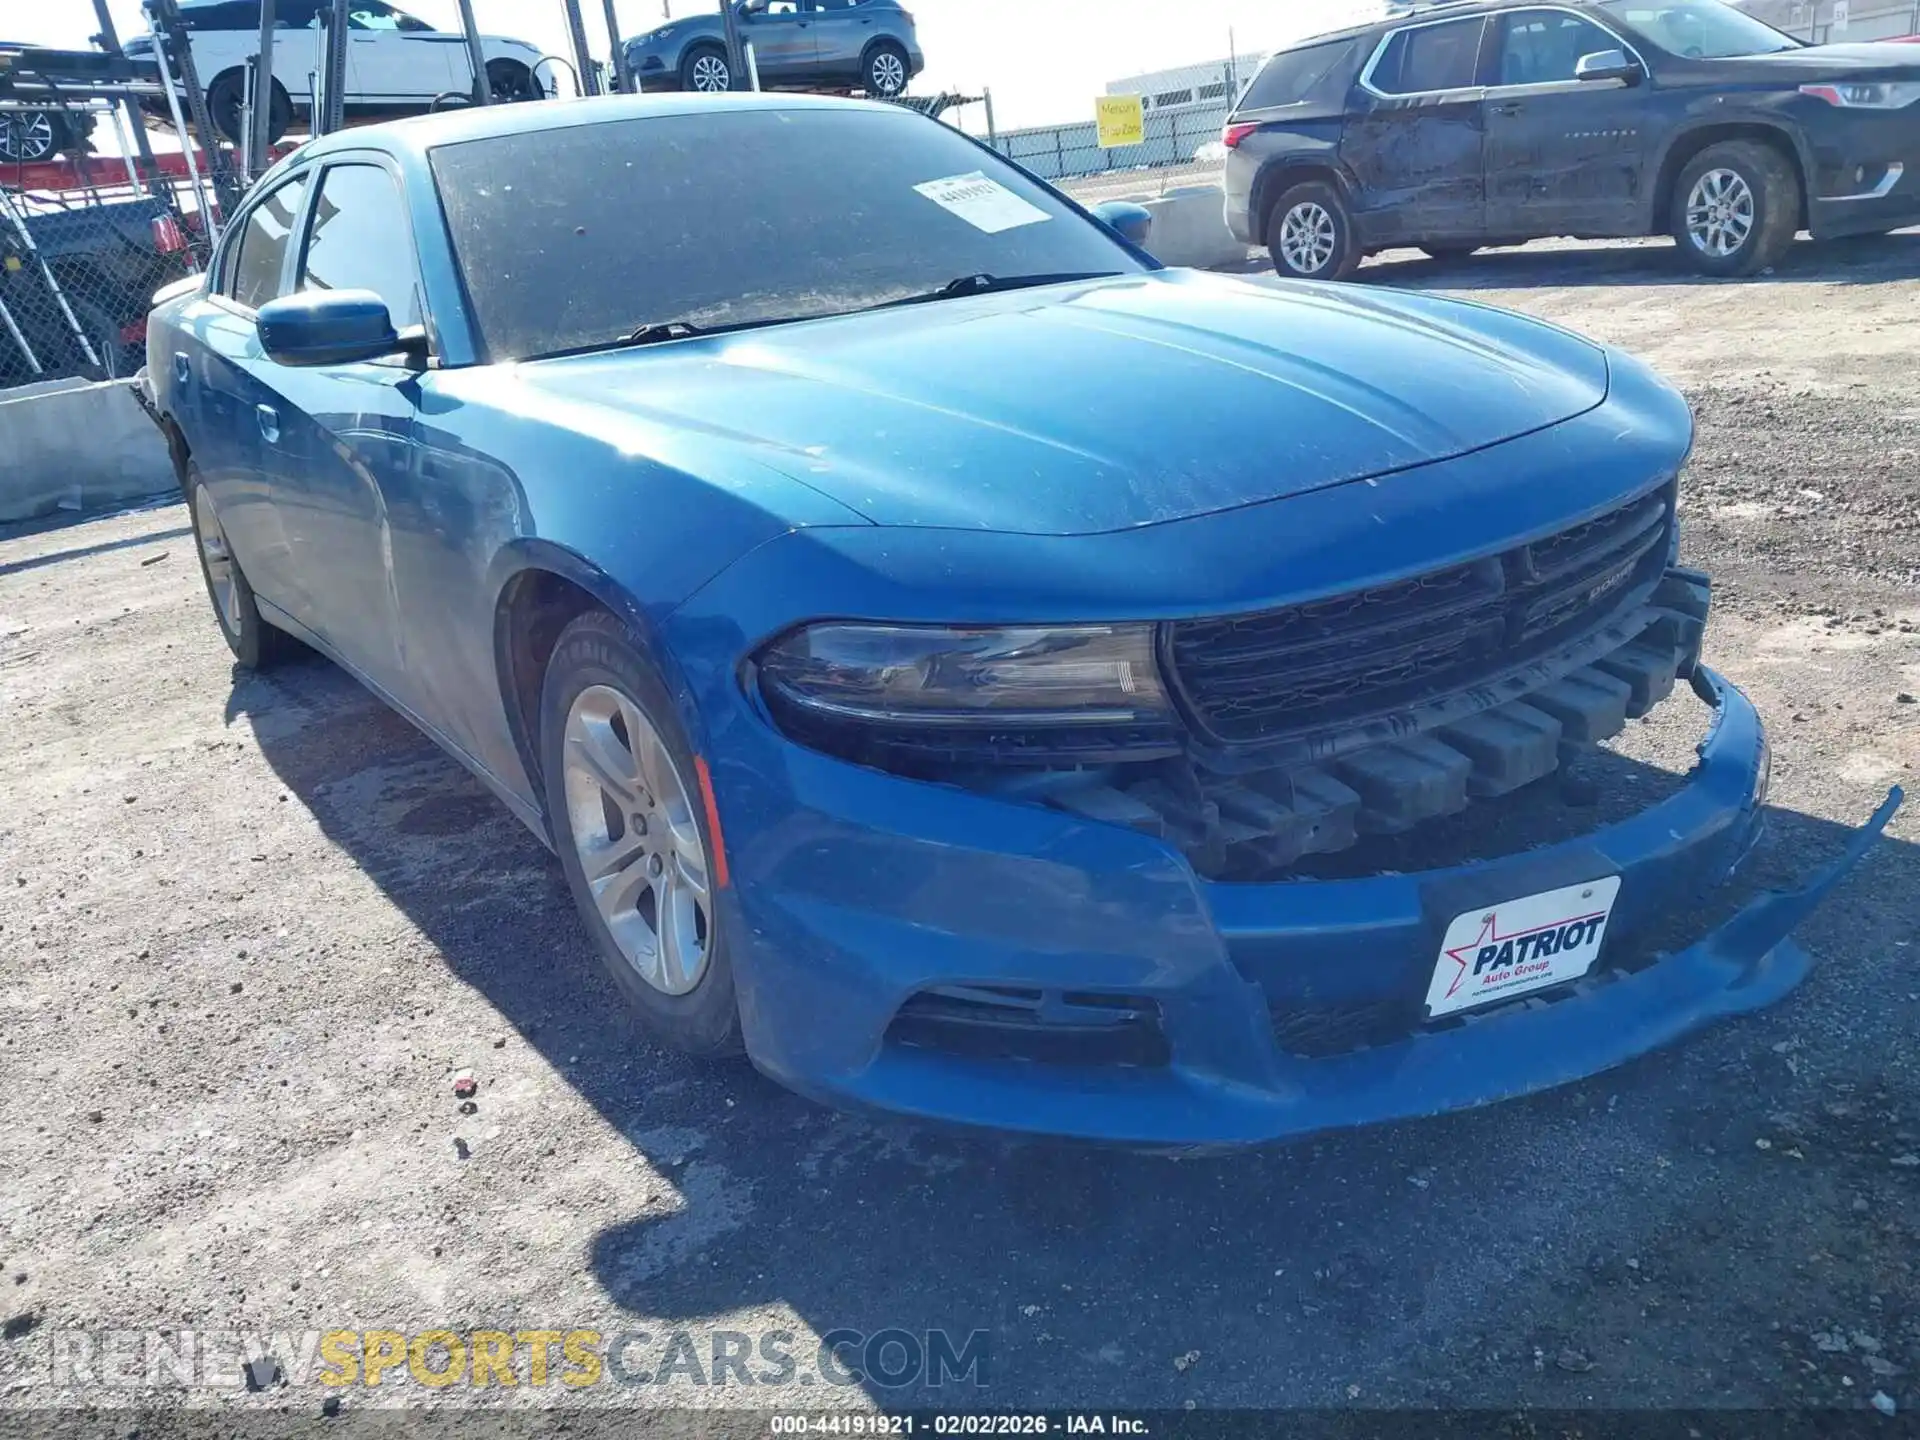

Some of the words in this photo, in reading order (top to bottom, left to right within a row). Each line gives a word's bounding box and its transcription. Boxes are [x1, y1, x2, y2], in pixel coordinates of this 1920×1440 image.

[1472, 916, 1606, 976] PATRIOT
[1482, 970, 1511, 985] Auto
[1514, 960, 1550, 976] Group
